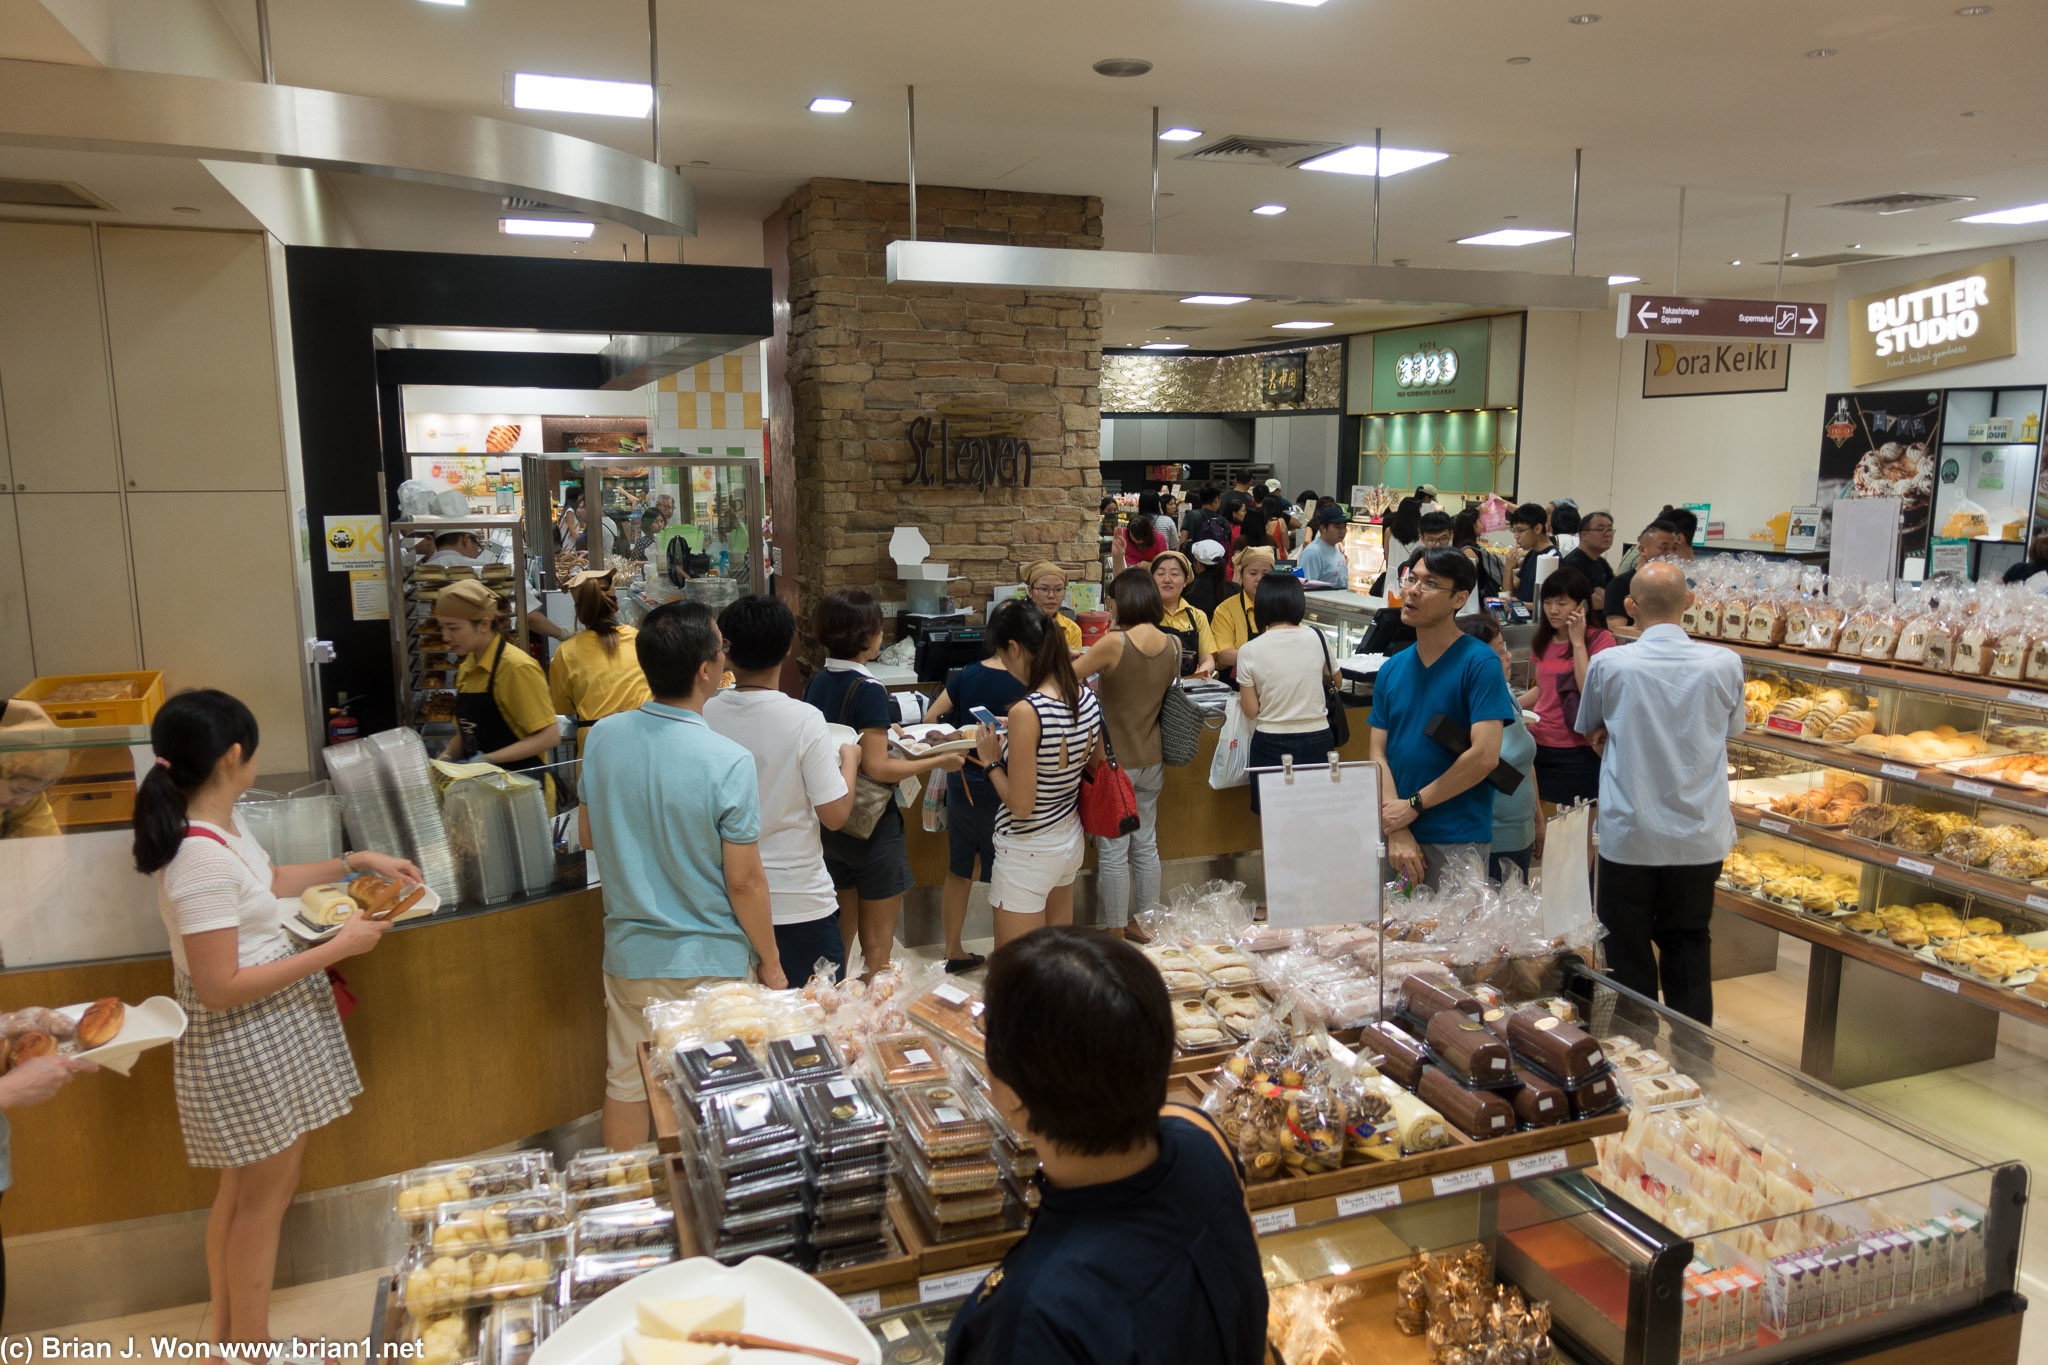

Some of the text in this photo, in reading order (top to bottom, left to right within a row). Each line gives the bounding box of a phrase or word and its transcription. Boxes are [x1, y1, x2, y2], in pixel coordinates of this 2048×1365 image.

[1661, 306, 1699, 317] Takashimaya
[1868, 276, 1989, 332] BUTTER
[1661, 315, 1682, 325] Square
[1738, 314, 1774, 323] Supermarket
[1875, 309, 1979, 357] STUDIO
[1714, 343, 1779, 374] Keiki
[1932, 345, 1967, 366] goodness
[1987, 431, 2007, 440] OUR
[941, 418, 1032, 494] Leaven
